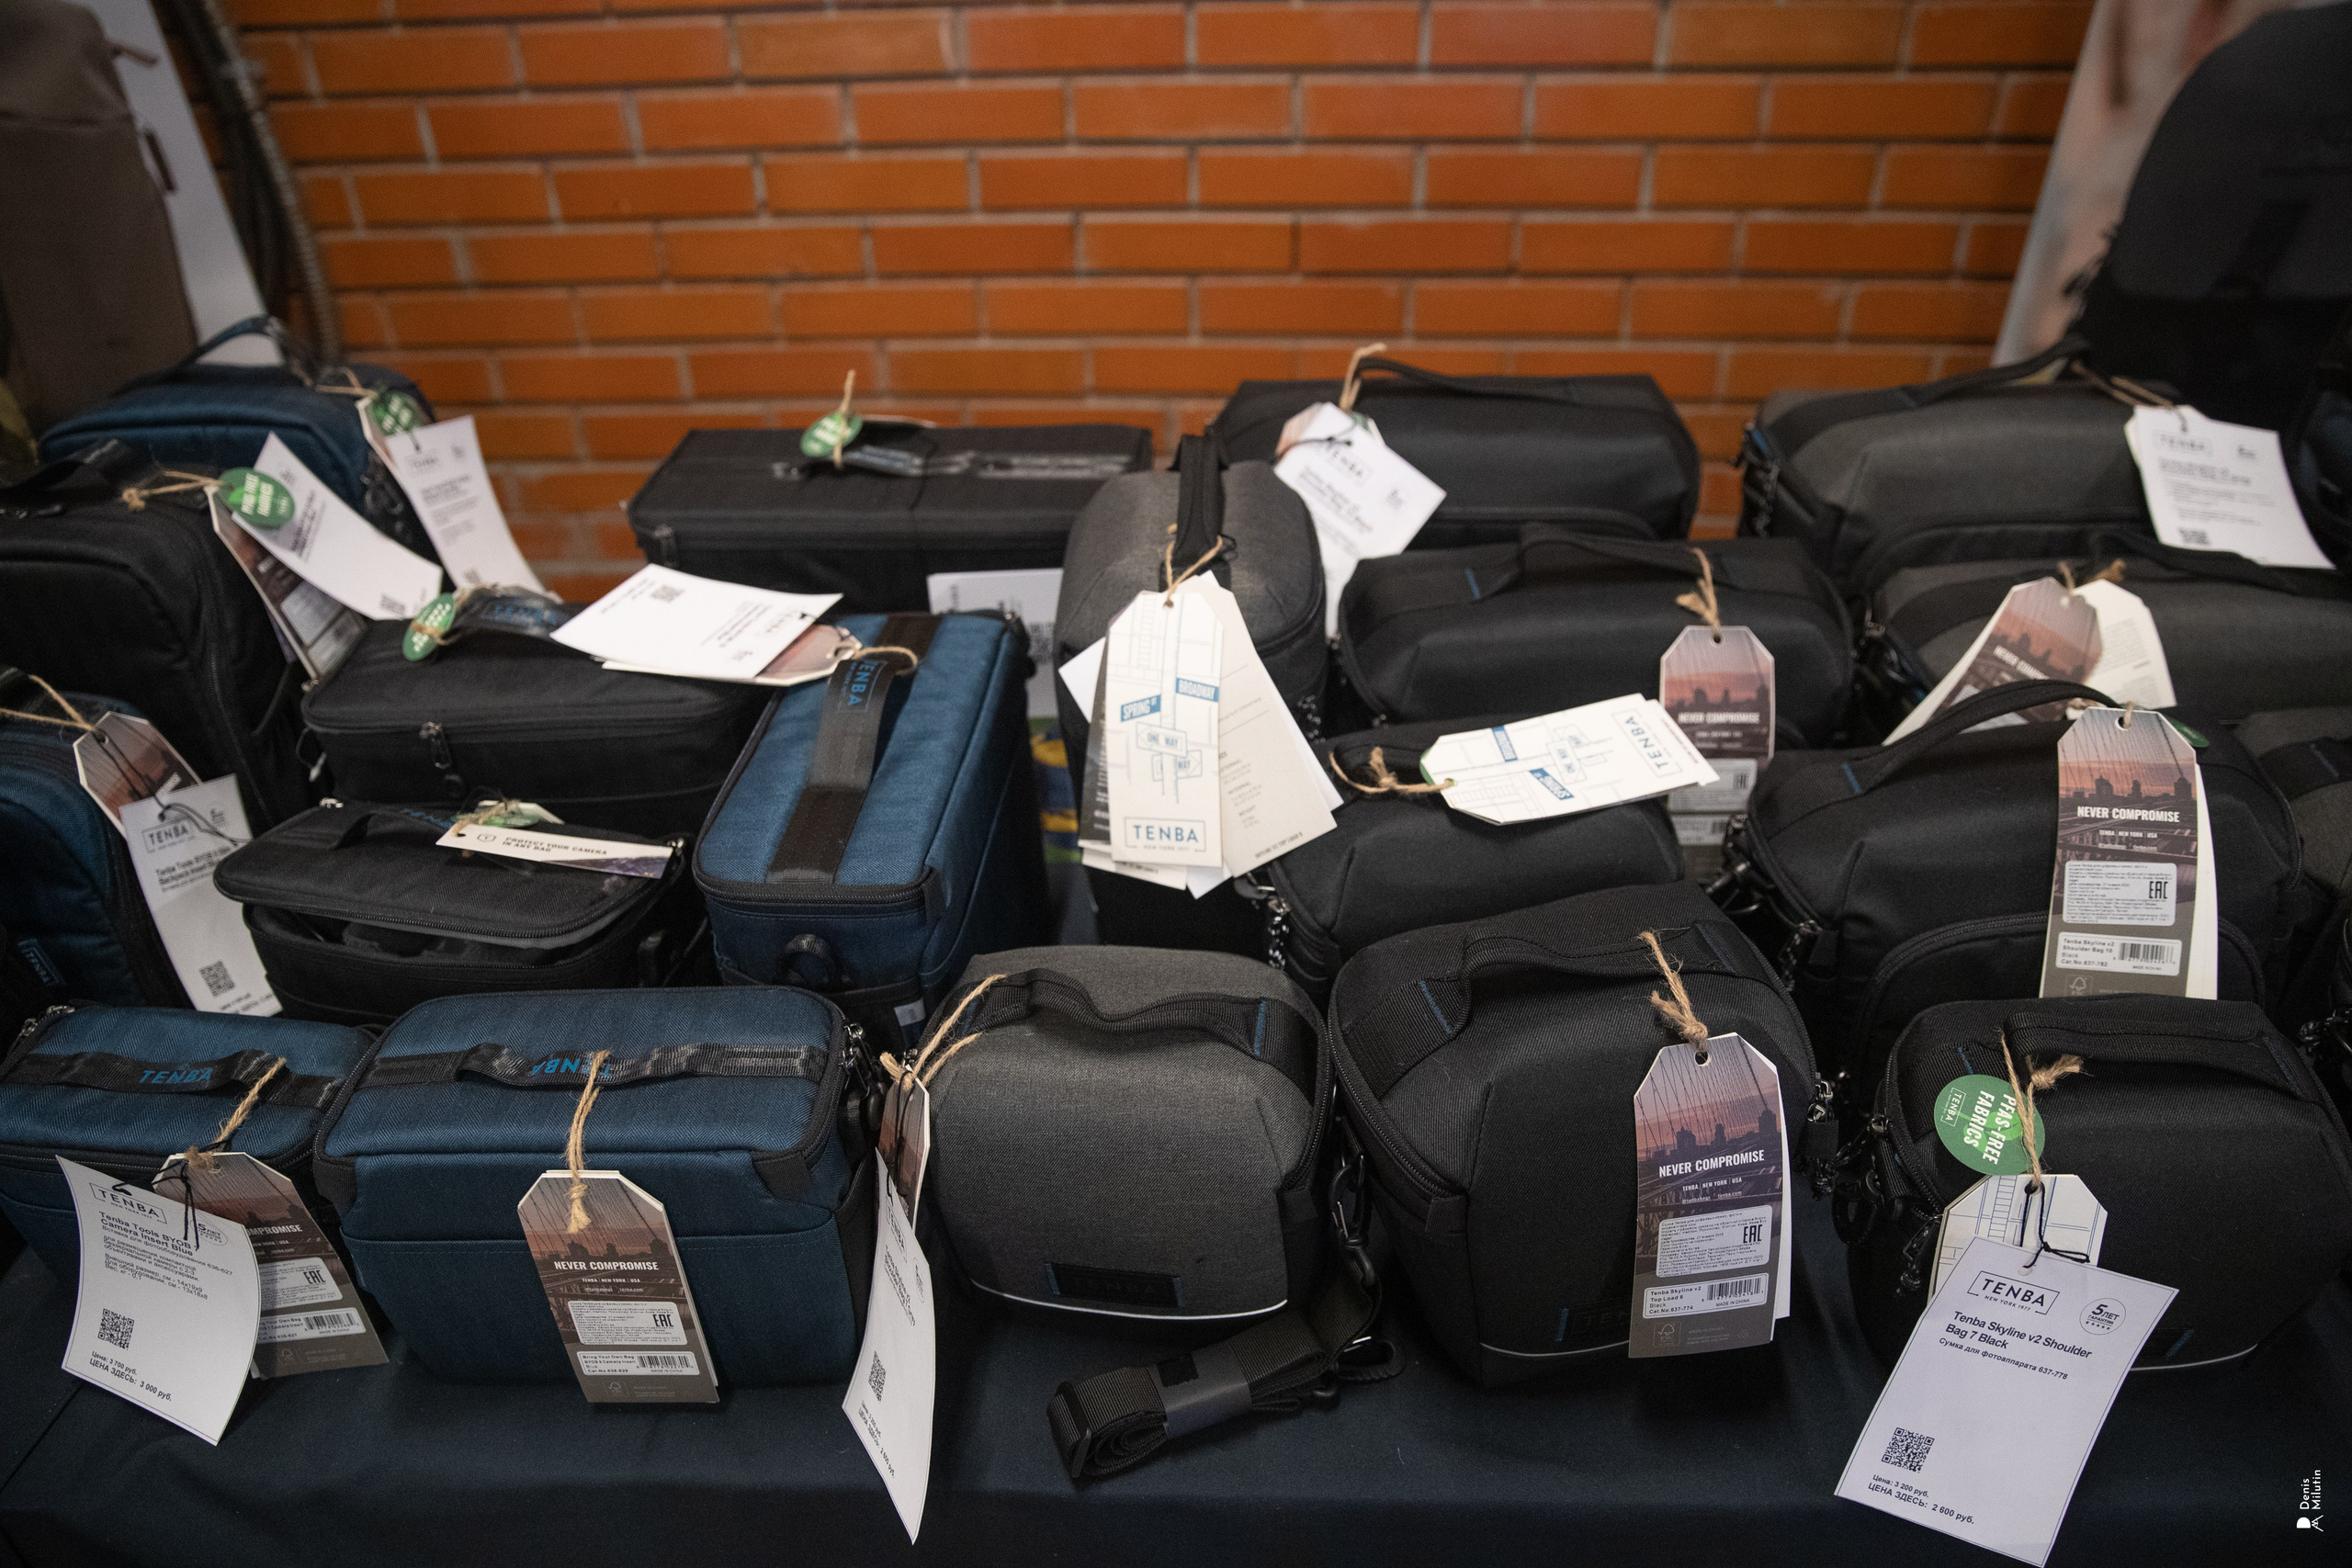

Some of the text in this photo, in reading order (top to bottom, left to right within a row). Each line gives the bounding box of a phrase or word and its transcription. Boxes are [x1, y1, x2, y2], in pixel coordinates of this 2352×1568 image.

[1123, 699, 1150, 720] SPRING
[1705, 712, 1760, 724] COMPROMISE
[1625, 716, 1669, 770] TENBA
[2077, 806, 2180, 823] NEVER COMPROMISE
[148, 825, 189, 845] TENBA
[1134, 825, 1198, 841] TENBA
[505, 836, 545, 848] PROTECT
[571, 848, 607, 856] CAMERA
[2149, 881, 2168, 899] EAC
[140, 1067, 214, 1084] TENBA
[1945, 1092, 1962, 1122] TENBA
[1963, 1090, 1996, 1147] FABRICS
[1983, 1094, 2017, 1165] PFAS-FREE
[1659, 1150, 1765, 1178] NEVER COMPROMISE
[98, 1189, 160, 1218] TENBA
[99, 1211, 192, 1250] Tenba Tools BYOB
[101, 1218, 193, 1257] Camera Insert Blue
[102, 1225, 129, 1239] Вставка
[198, 1223, 207, 1231] 5
[1743, 1224, 1762, 1244] EAC
[554, 1261, 660, 1270] NEVER COMPROMISE
[303, 1269, 326, 1284] EAC
[1981, 1279, 2046, 1307] TENBA
[1984, 1295, 2030, 1312] NEW YORK 1977
[653, 1314, 674, 1326] EAC
[2087, 1314, 2114, 1325] ГАРАНТИИ
[2091, 1303, 2120, 1322] 5 ЛЕТ
[1946, 1324, 2008, 1349] Bag 7 Black
[1953, 1311, 2092, 1359] Tenba Skyline v2 Shoulder
[92, 1351, 108, 1361] Цена:
[114, 1360, 125, 1369] 700
[125, 1367, 137, 1375] руб.
[1939, 1337, 2068, 1381] Сумка для фотоаппарата 637-778
[90, 1358, 109, 1371] ЦЕНА
[110, 1368, 137, 1384] ЗДЕСЬ:
[145, 1383, 157, 1393] 000
[157, 1391, 172, 1401] руб.
[1872, 1474, 1894, 1486] Цена:
[1900, 1483, 1913, 1492] 200
[1913, 1487, 1929, 1498] руб.
[1868, 1482, 1893, 1496] ЦЕНА
[1894, 1491, 1928, 1508] ЗДЕСЬ:
[1939, 1506, 1955, 1517] 600
[1955, 1513, 1974, 1524] руб.
